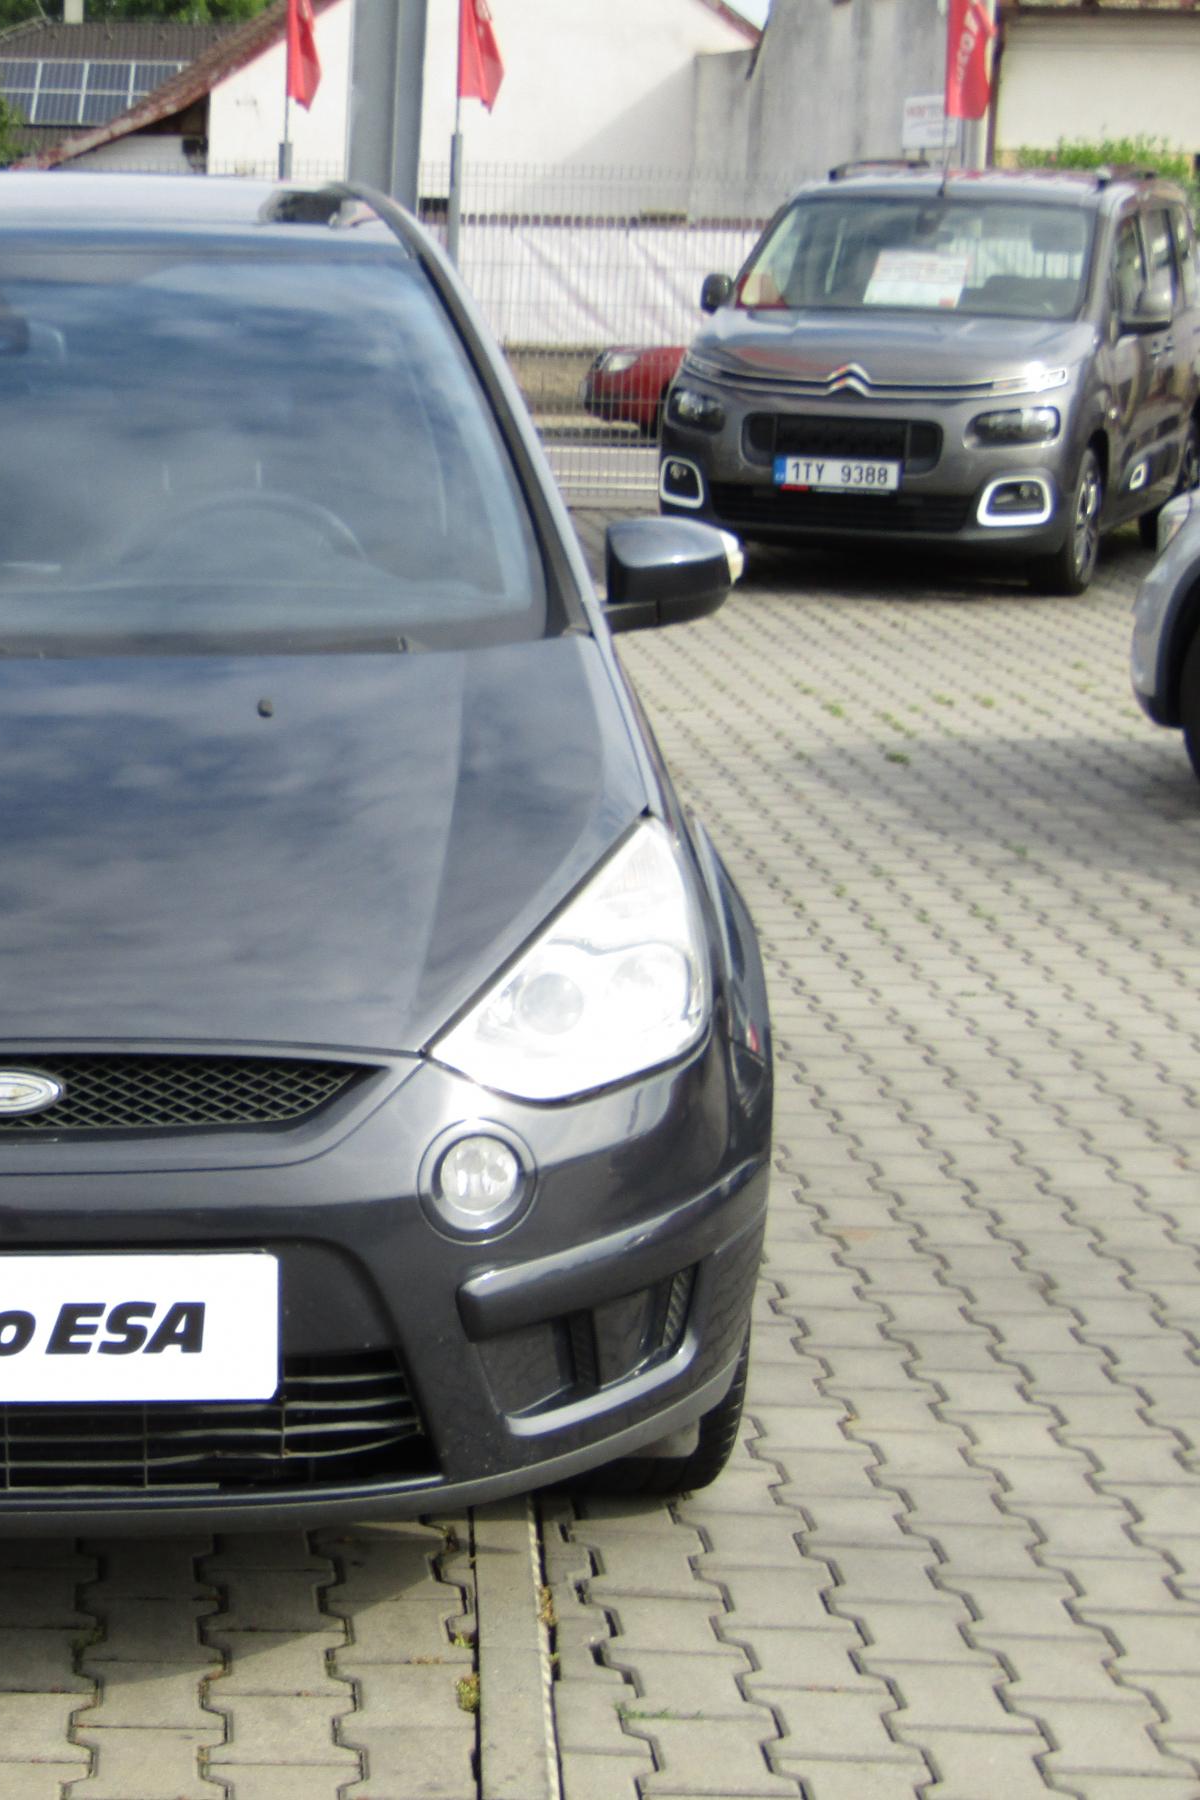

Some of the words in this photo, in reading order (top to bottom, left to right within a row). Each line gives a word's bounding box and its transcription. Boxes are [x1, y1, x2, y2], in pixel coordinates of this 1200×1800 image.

[792, 461, 825, 482] 1TY
[841, 464, 889, 485] 9388
[45, 1301, 206, 1355] ESA
